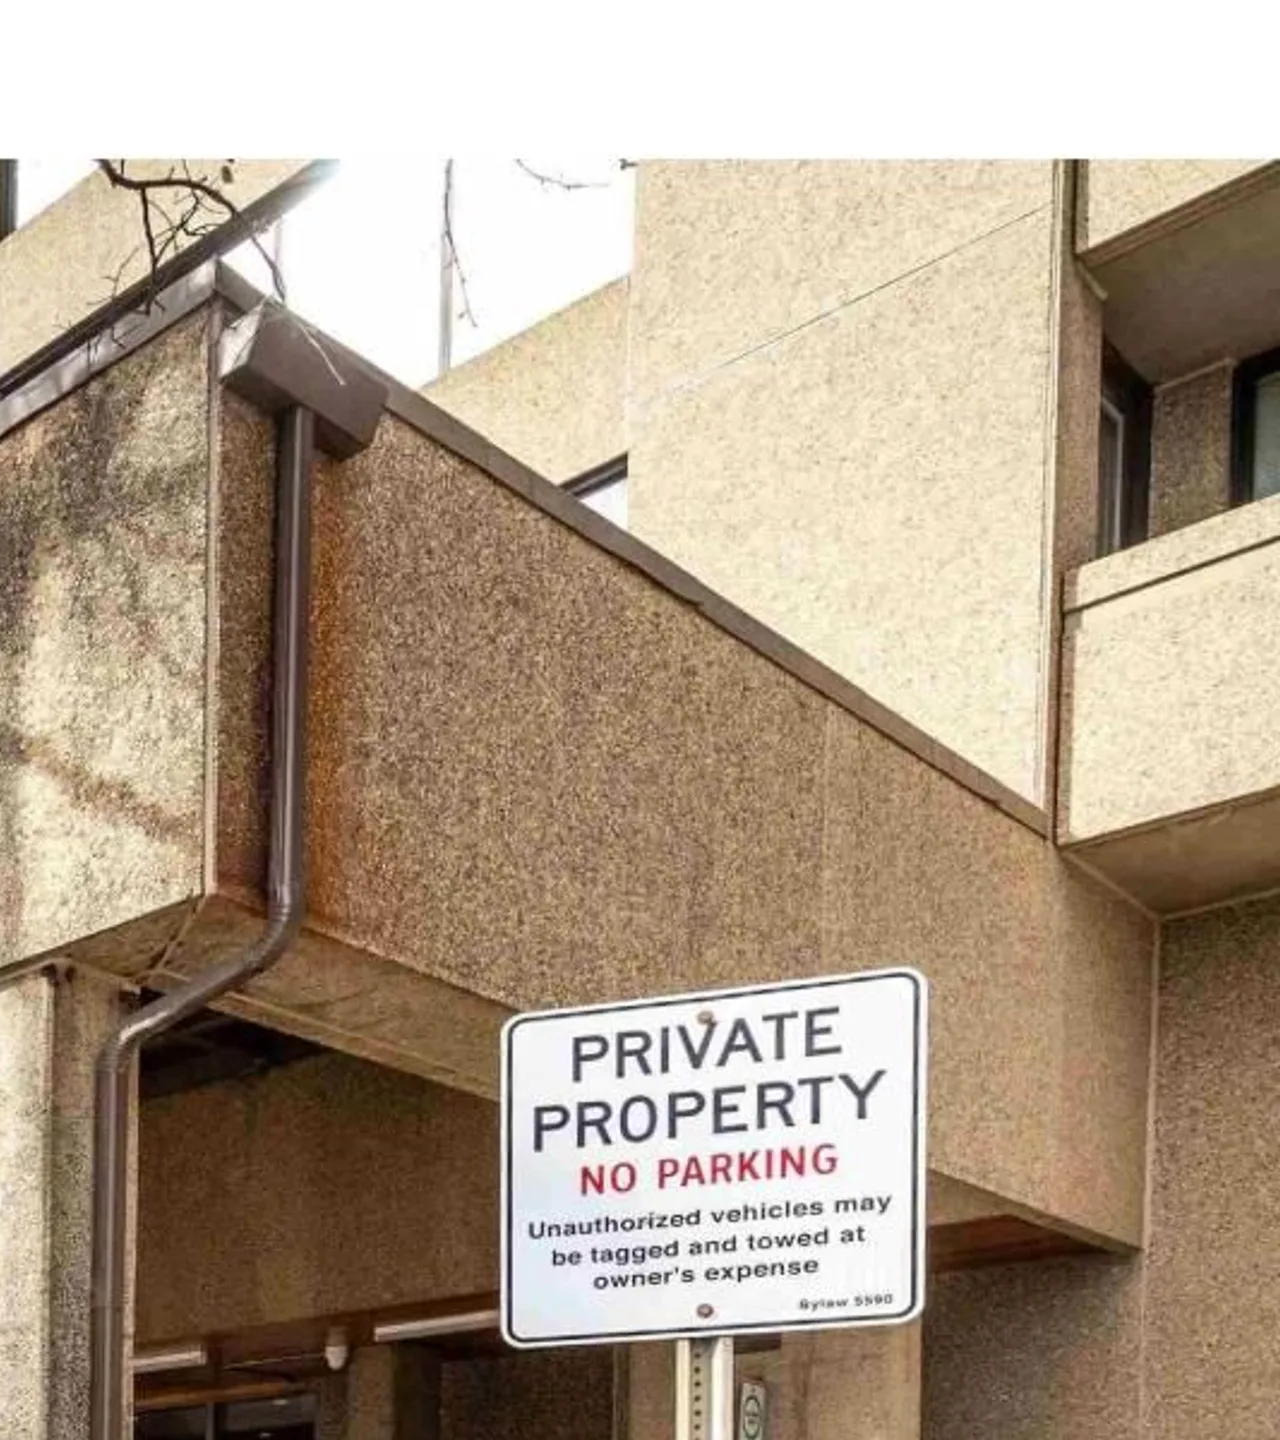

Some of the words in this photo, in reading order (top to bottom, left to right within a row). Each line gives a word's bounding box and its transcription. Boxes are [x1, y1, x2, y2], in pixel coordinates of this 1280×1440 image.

[572, 1006, 842, 1083] PRIVATE
[533, 1069, 887, 1153] PROPERTY
[580, 1162, 636, 1196] NO
[657, 1143, 839, 1189] PARKING
[529, 1208, 701, 1239] Unauthorized
[711, 1201, 824, 1224] vehicles
[834, 1195, 892, 1215] may
[552, 1247, 582, 1266] be
[591, 1242, 679, 1270] tagged
[689, 1236, 737, 1256] and
[747, 1230, 829, 1251] towed
[840, 1226, 866, 1243] at
[593, 1266, 694, 1290] owner's
[704, 1259, 819, 1283] expense
[799, 1298, 848, 1311] Bylaw
